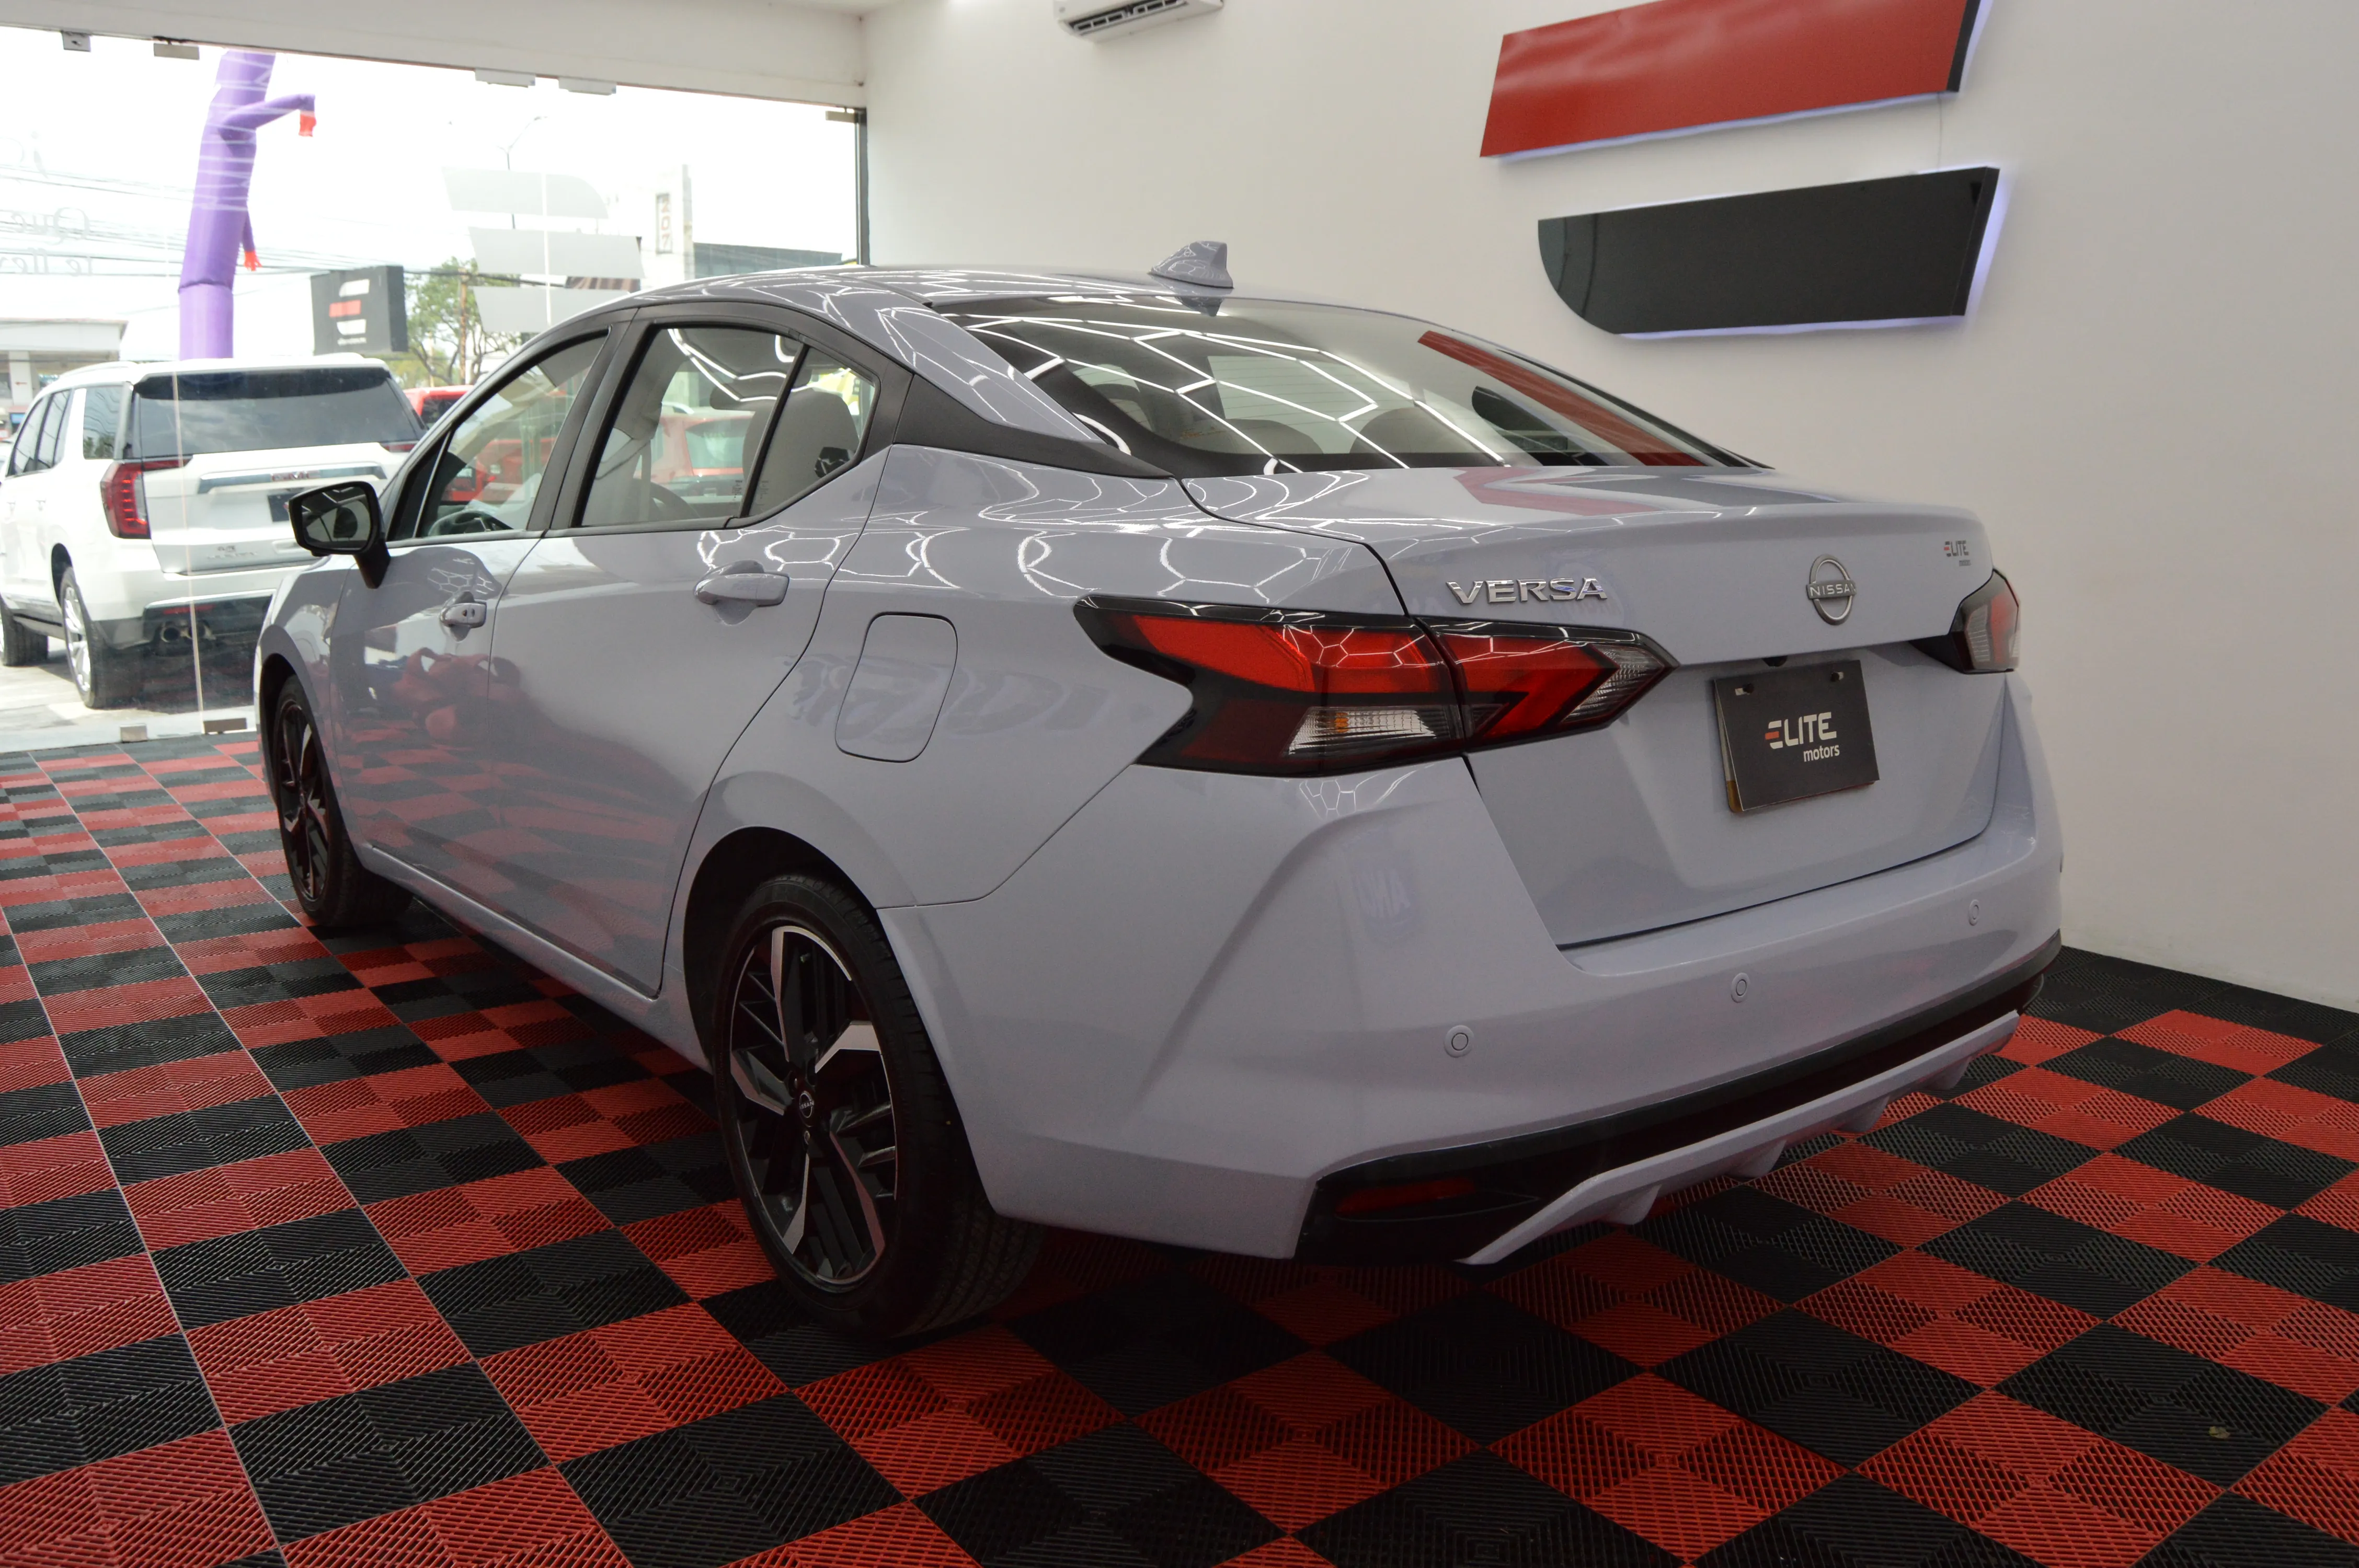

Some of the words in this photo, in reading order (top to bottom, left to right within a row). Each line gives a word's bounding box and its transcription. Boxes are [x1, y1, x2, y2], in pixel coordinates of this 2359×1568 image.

[1943, 540, 1969, 557] ELITE
[1445, 577, 1608, 605] VERSA
[1809, 583, 1856, 597] NISSAN
[1765, 711, 1837, 749] ELITE
[1803, 744, 1840, 763] motors
